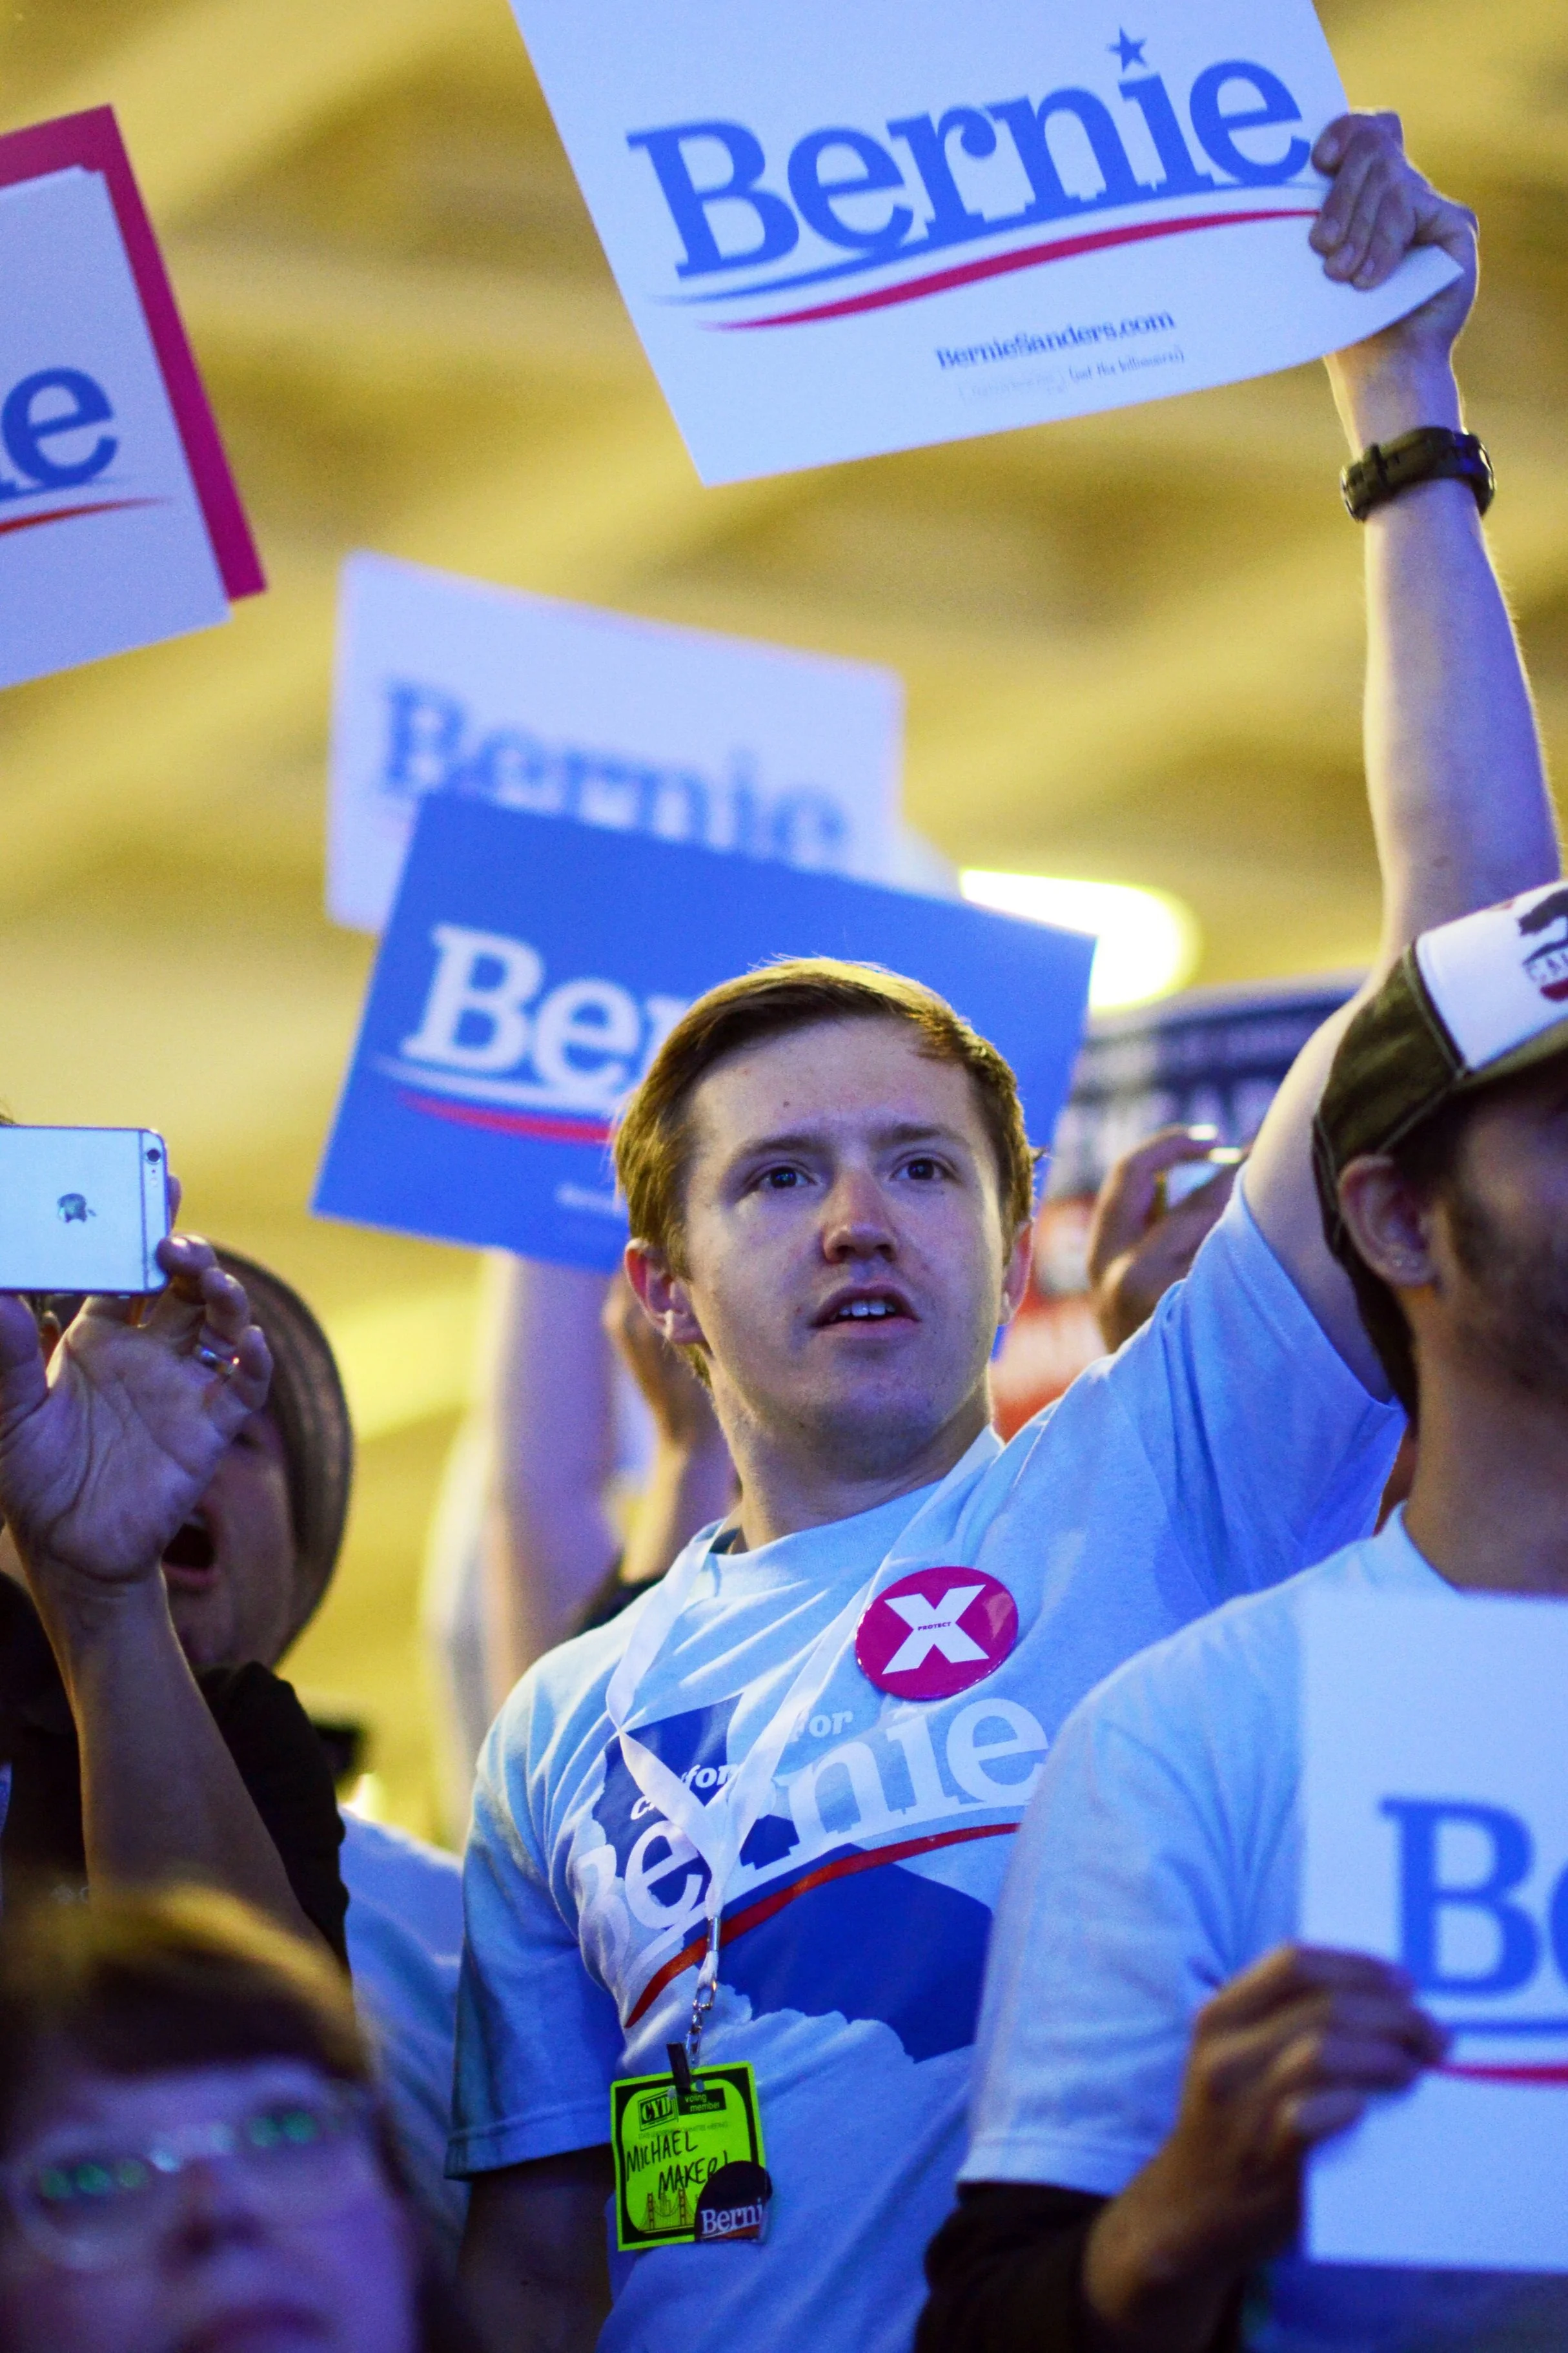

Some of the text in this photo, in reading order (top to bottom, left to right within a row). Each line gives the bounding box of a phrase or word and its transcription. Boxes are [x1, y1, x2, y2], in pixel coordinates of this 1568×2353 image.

[625, 27, 1310, 279] Bernie
[935, 309, 1176, 370] BernieSanders.com
[0, 366, 118, 502] e
[917, 1621, 952, 1631] PROTECT
[1378, 1793, 1568, 1998] B
[684, 2093, 708, 2104] voting
[689, 2101, 720, 2112] member
[626, 2128, 698, 2182] MICHAEL
